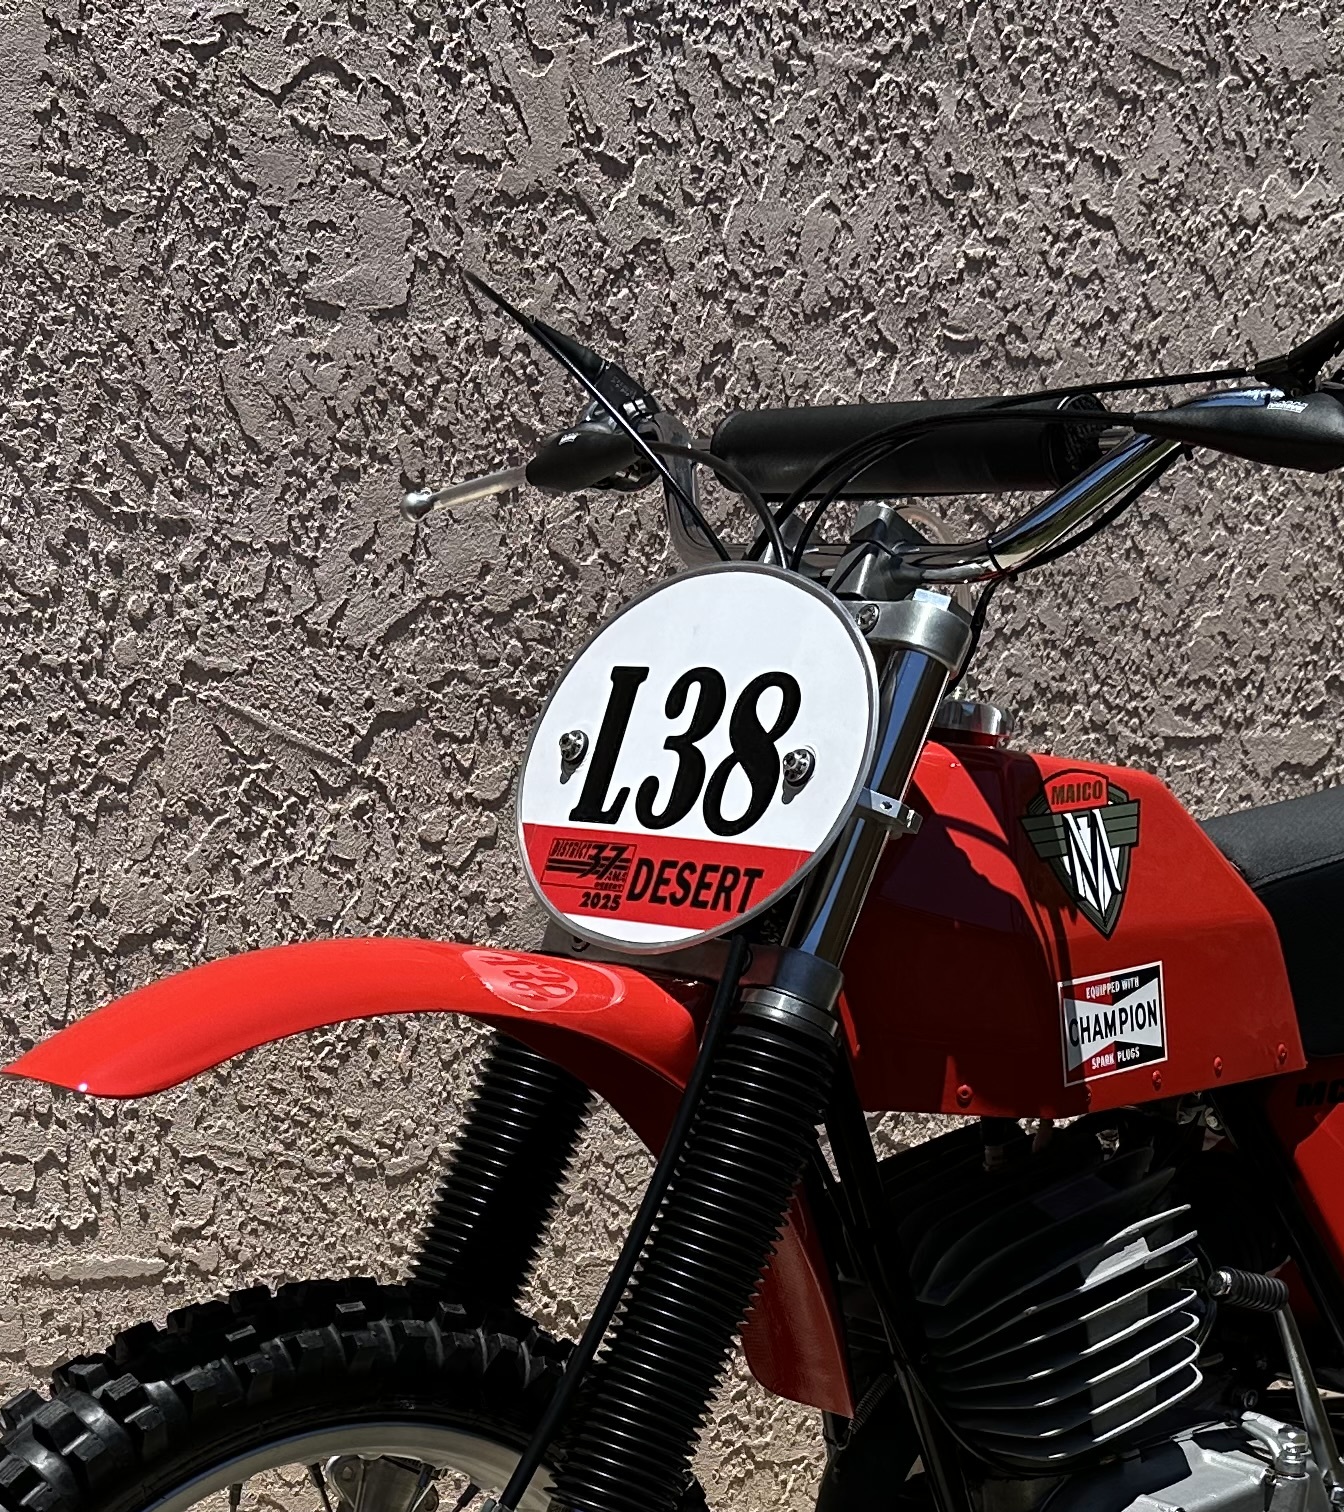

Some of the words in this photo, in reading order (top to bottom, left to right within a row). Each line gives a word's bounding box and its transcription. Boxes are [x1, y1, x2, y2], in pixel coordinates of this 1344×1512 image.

[568, 665, 802, 837] L38
[1051, 780, 1103, 806] MAICO
[625, 857, 765, 914] DESERT
[578, 891, 622, 911] 2025
[1085, 979, 1120, 1000] EQUIPPED
[1121, 975, 1140, 991] WITH
[1068, 999, 1158, 1047] CHAMPION
[1091, 1052, 1115, 1070] SPARK
[1117, 1046, 1140, 1063] PLUGS
